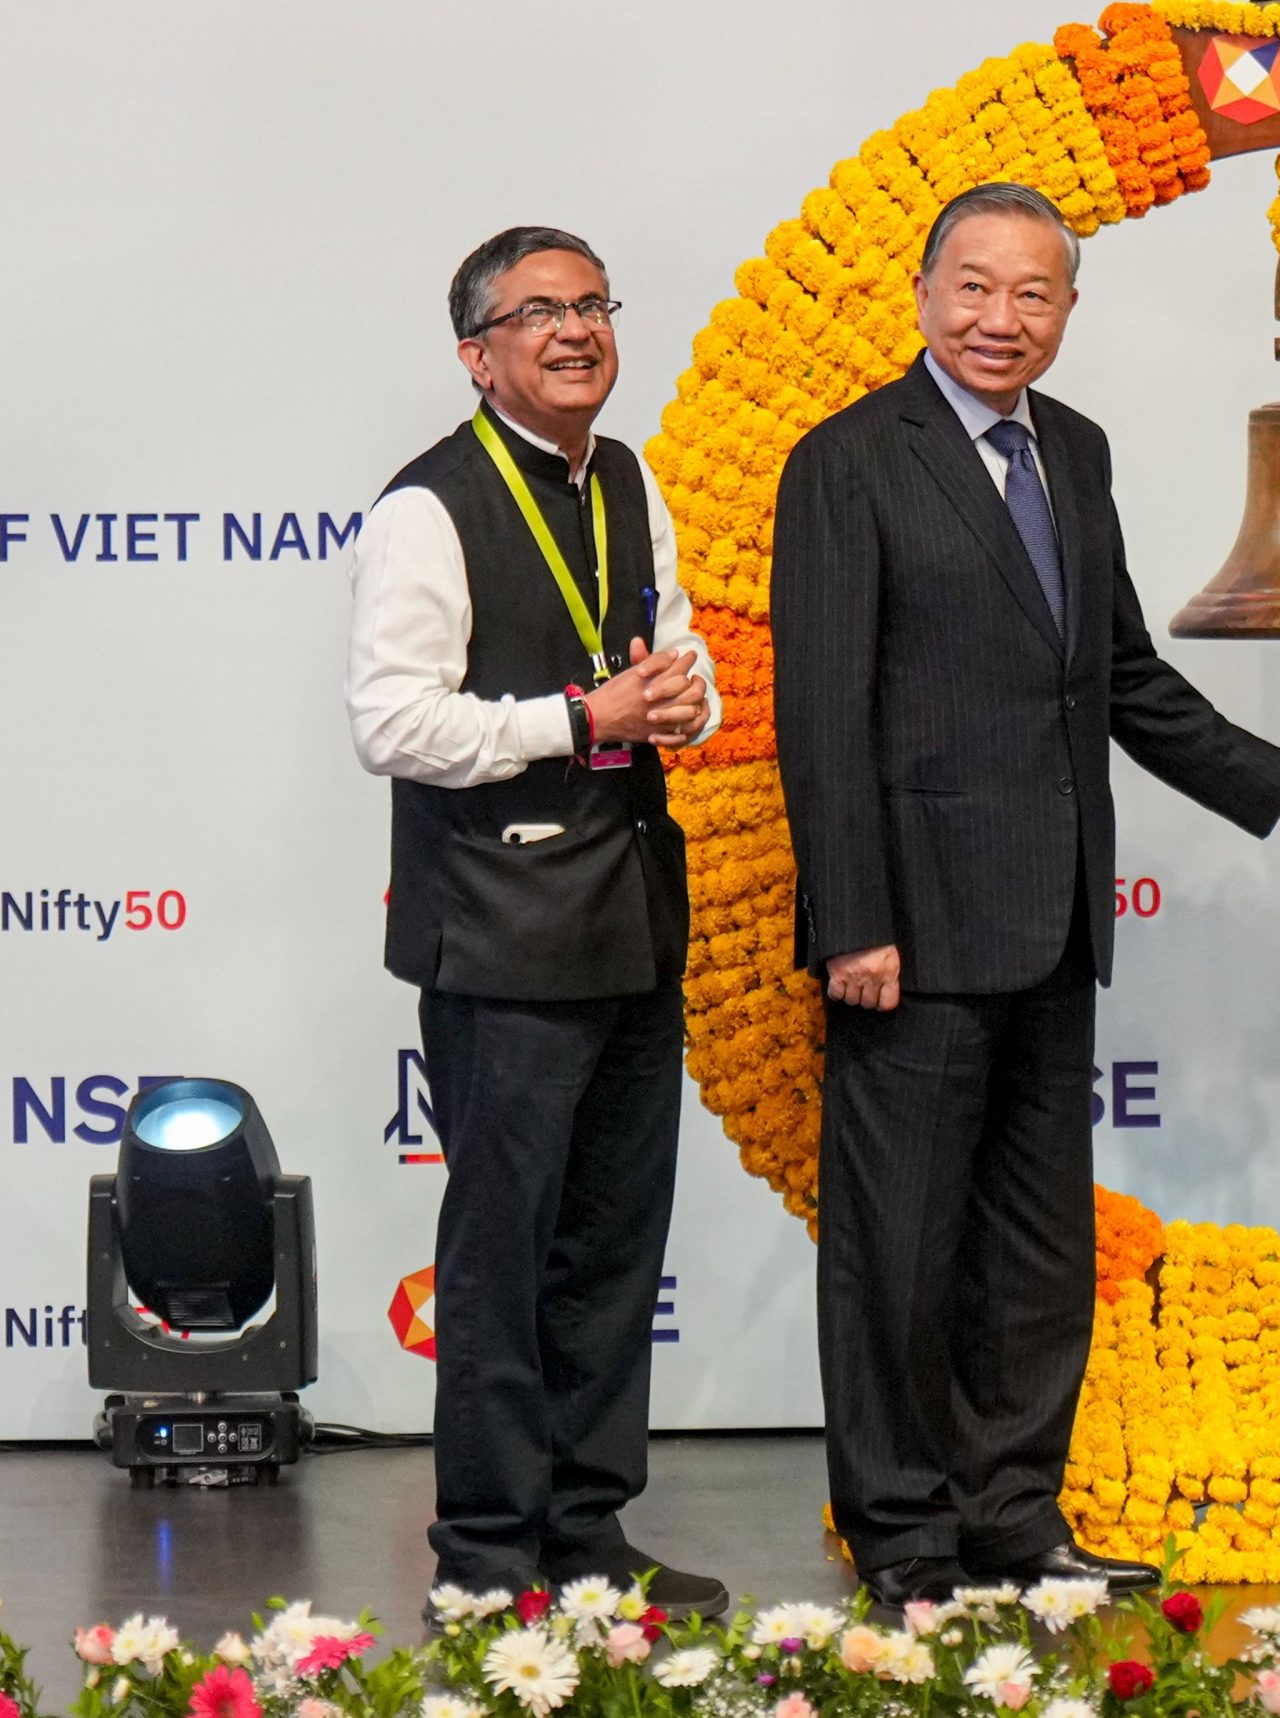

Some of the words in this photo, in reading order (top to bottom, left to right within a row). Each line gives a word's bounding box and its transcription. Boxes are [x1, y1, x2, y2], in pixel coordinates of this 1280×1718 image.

[50, 513, 200, 562] VIET
[223, 512, 362, 561] NAM
[1, 888, 187, 941] Nifty50
[12, 1074, 184, 1145] NS
